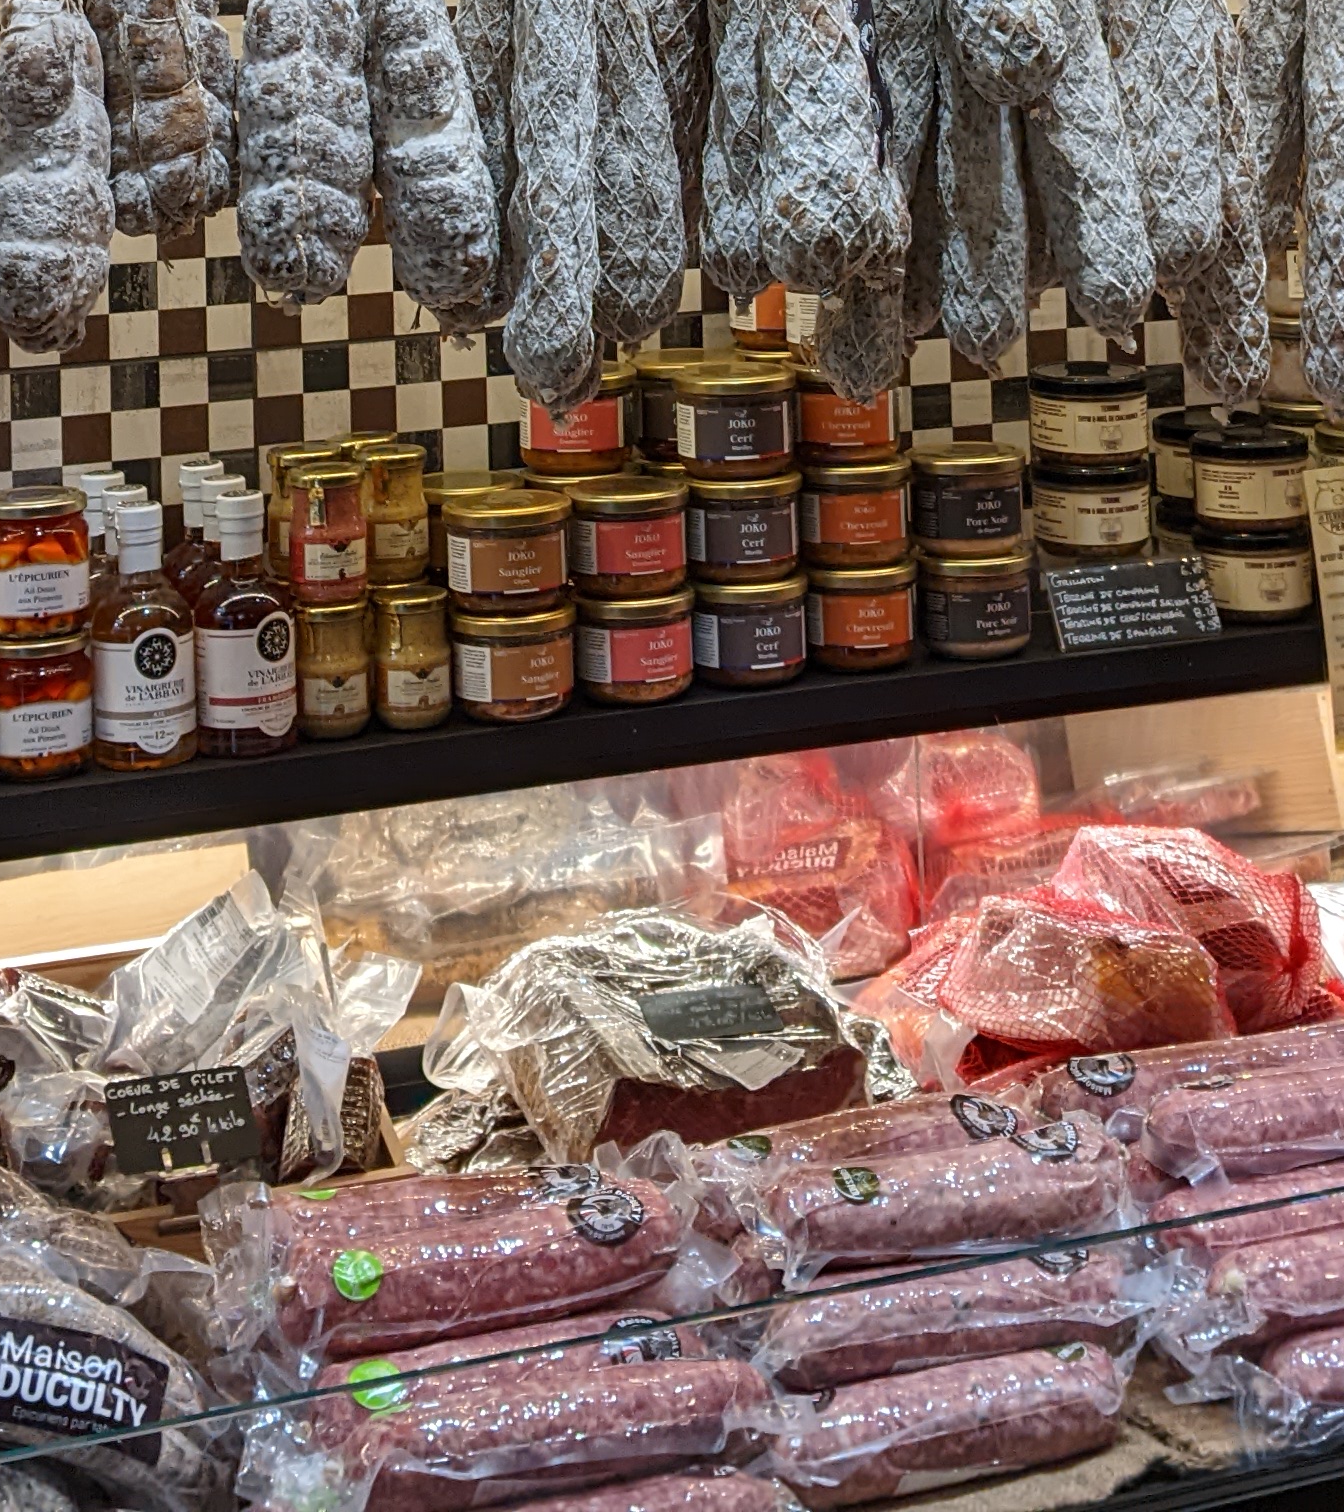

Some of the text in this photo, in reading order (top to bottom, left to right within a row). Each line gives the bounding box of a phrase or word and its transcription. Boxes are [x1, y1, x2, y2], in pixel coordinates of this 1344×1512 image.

[565, 413, 588, 423] OKO
[728, 418, 756, 430] JOKO
[729, 433, 754, 444] Cerf
[976, 500, 1001, 511] JOKO
[739, 523, 767, 533] JOKO
[741, 538, 764, 548] Cerf
[508, 551, 535, 562] JOKO
[499, 566, 542, 579] Sanglier
[986, 601, 1011, 613] JOKO
[858, 608, 884, 618] JOKO
[755, 626, 781, 637] JOKO
[649, 639, 673, 650] JOKO
[757, 641, 780, 651] Cerf
[529, 656, 554, 668] JOKO
[107, 1085, 153, 1100] COEUR
[158, 1079, 180, 1092] DE
